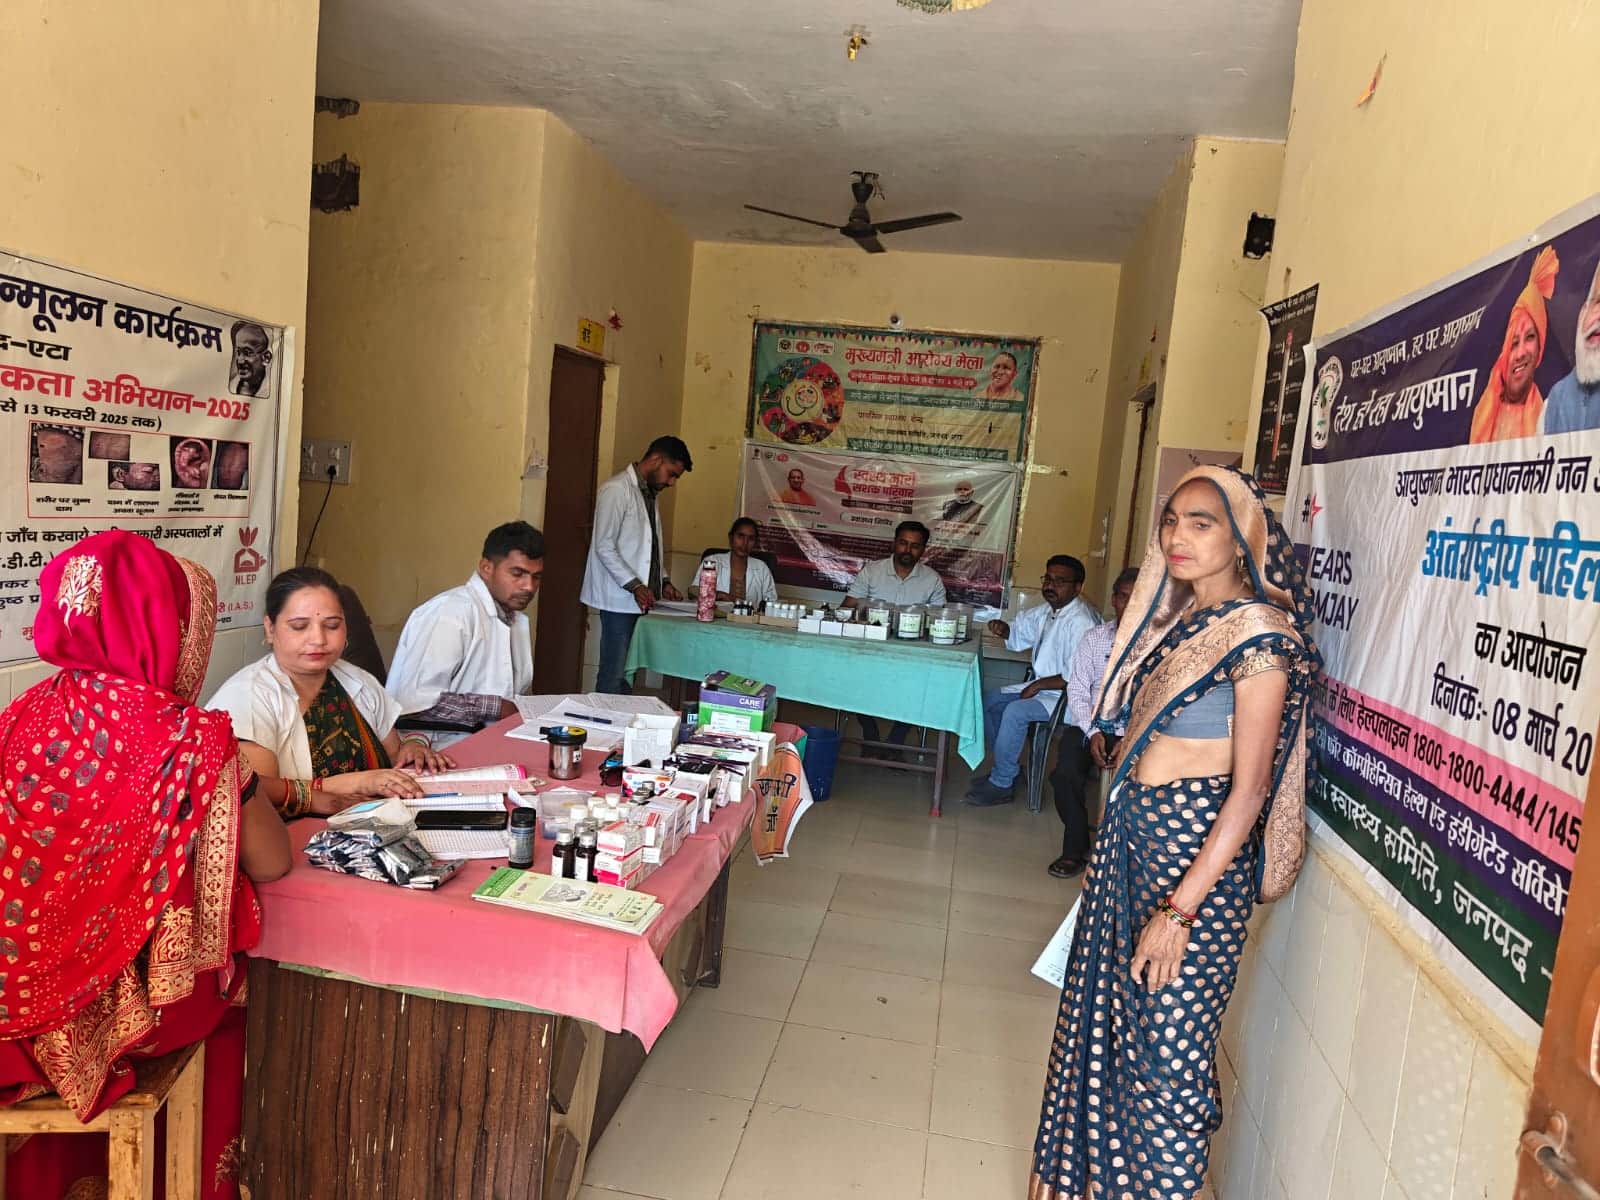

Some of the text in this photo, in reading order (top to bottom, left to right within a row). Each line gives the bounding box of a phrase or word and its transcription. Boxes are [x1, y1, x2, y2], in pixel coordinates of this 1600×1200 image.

[114, 304, 222, 352] कार्यक्रम
[1440, 306, 1487, 349] आयुष्मान
[845, 346, 902, 367] मुख्यमंत्री
[905, 351, 953, 370] आरोग्य
[955, 353, 984, 370] मेला
[24, 404, 39, 415] 13
[44, 404, 96, 422] फरवरी
[100, 413, 128, 425] 2025
[132, 415, 162, 431] तक)
[82, 374, 250, 421] अभियान-2025
[1391, 368, 1478, 430] आयुष्मान
[1395, 468, 1443, 505] आयुष्मान
[1445, 466, 1482, 498] भारत
[1483, 446, 1555, 497] प्रधानमंत्री
[1556, 455, 1592, 493] जन
[7, 527, 37, 543] जाँच
[164, 525, 212, 540] अस्पतालों
[214, 525, 223, 539] में
[235, 574, 257, 585] NLEP
[1310, 588, 1359, 632] MJAY
[1474, 621, 1587, 692] का आयोजन
[739, 697, 761, 708] CARE
[1431, 661, 1592, 776] दिनांक:- 08 मार्च 20
[1337, 690, 1358, 723] लिए
[1356, 695, 1412, 753] हेल्पलाइन
[1413, 733, 1582, 854] 1800-1800-4444/145
[1402, 777, 1428, 819] हेल्थ
[1429, 797, 1448, 832] एंड
[1511, 856, 1569, 917] सर्विसे
[1330, 783, 1382, 843] स्वास्थ्य
[1383, 824, 1443, 905] समिति,
[1453, 879, 1533, 983] जनपद
